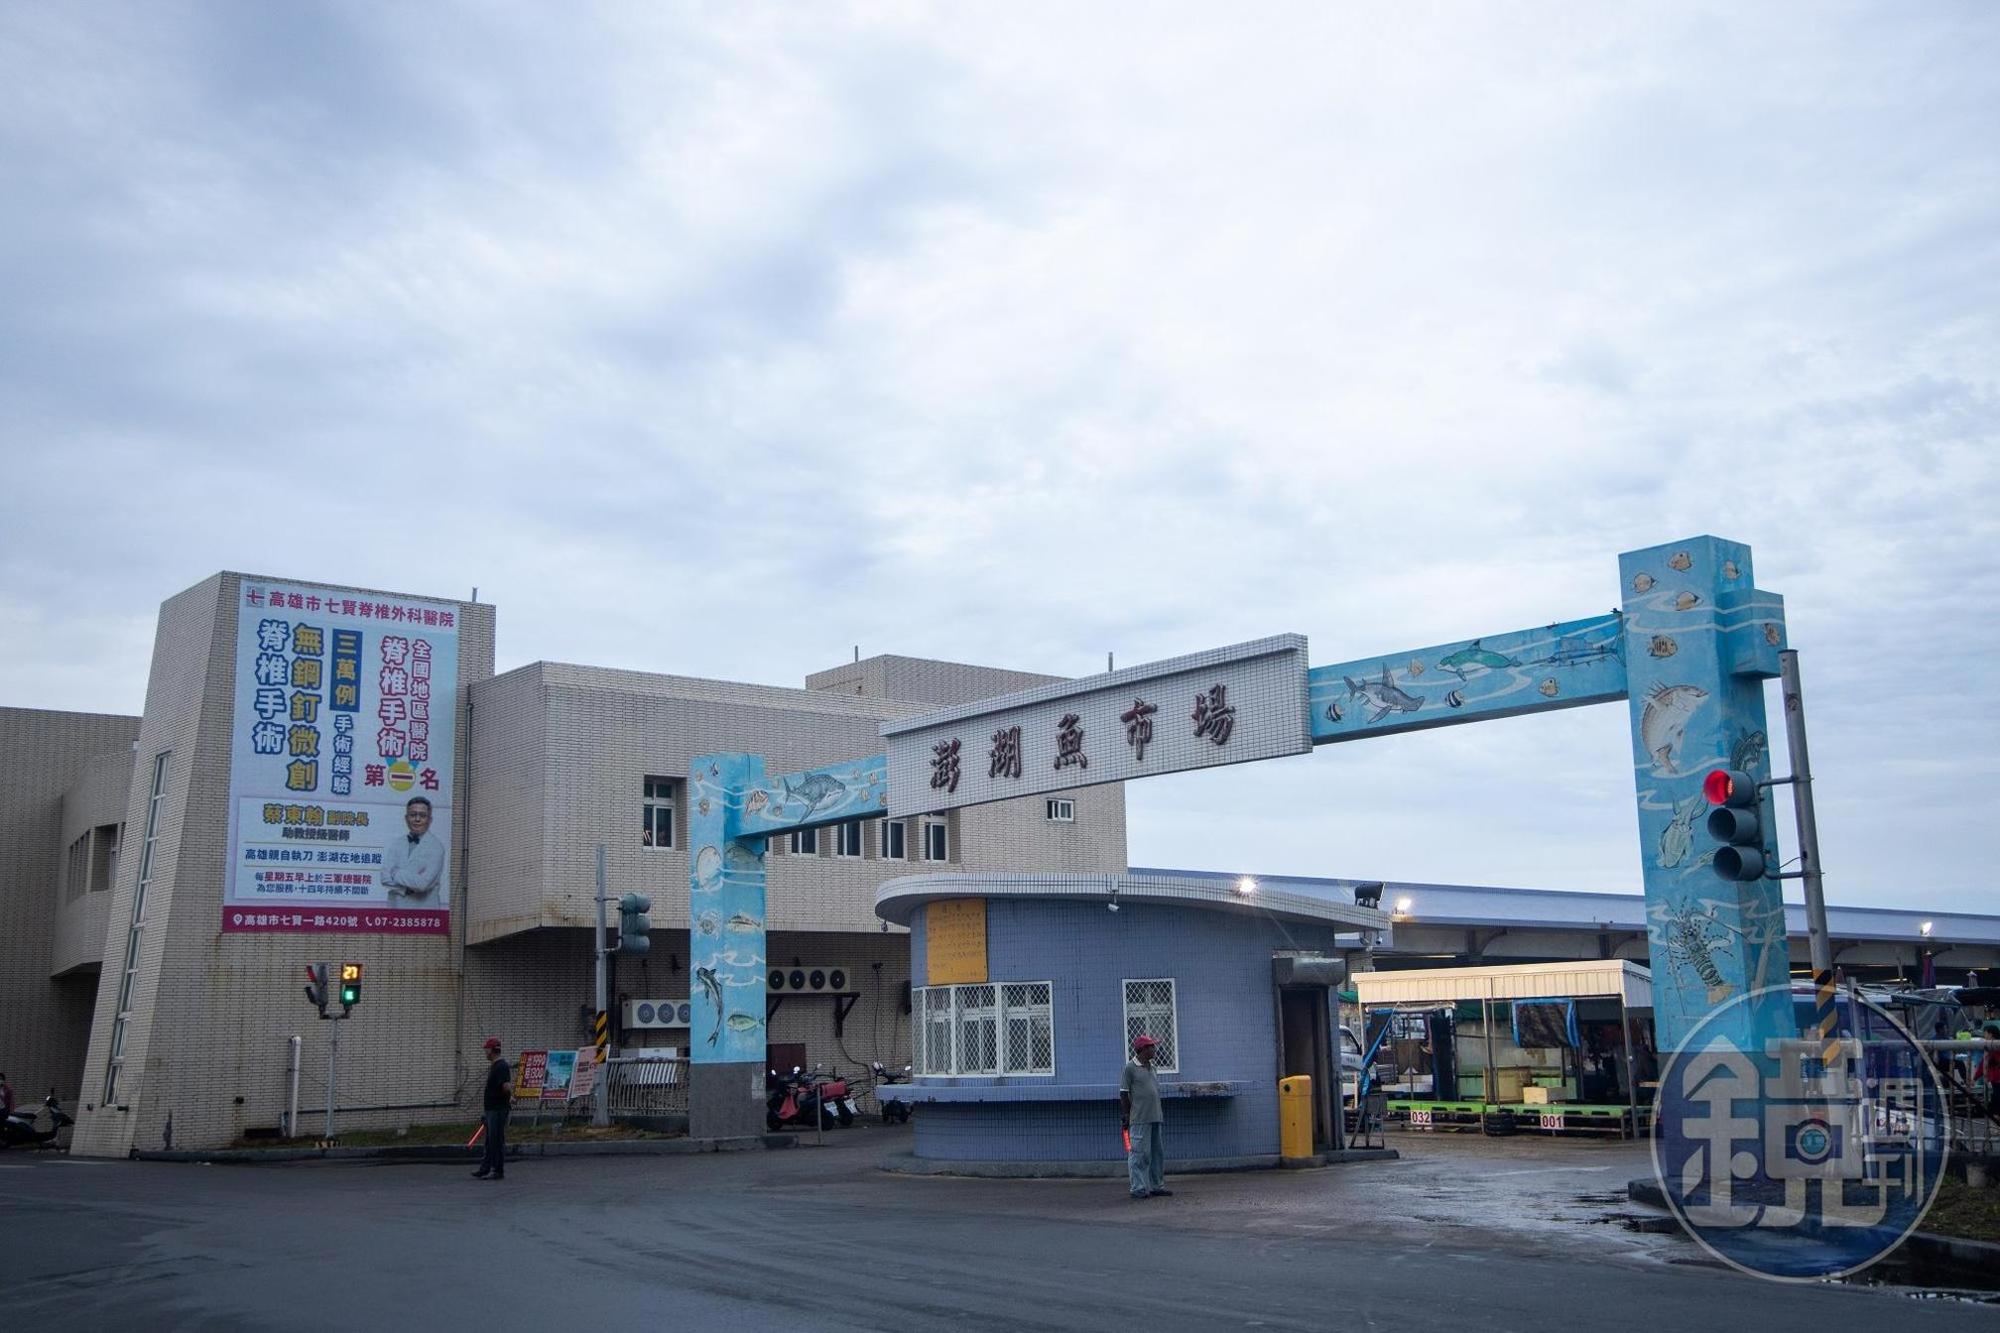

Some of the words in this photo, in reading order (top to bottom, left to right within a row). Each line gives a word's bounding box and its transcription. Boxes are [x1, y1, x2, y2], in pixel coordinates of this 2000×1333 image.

[269, 591, 455, 627] 高雄市七賢脊椎外科醫院
[252, 619, 290, 755] 脊椎手術
[334, 633, 357, 706] 三萬例
[377, 636, 409, 757] 脊椎手術
[409, 639, 431, 761] 全國地區醫院
[286, 623, 324, 791] 無鋼釘微創
[929, 683, 1237, 793] 澎湖魚市場
[331, 715, 353, 794] 手術經驗
[365, 764, 439, 790] 第一名
[245, 849, 313, 862] 高雄親自執刀
[374, 916, 441, 927] 07-2385878
[1412, 1111, 1430, 1123] 032
[1542, 1115, 1562, 1127] 001
